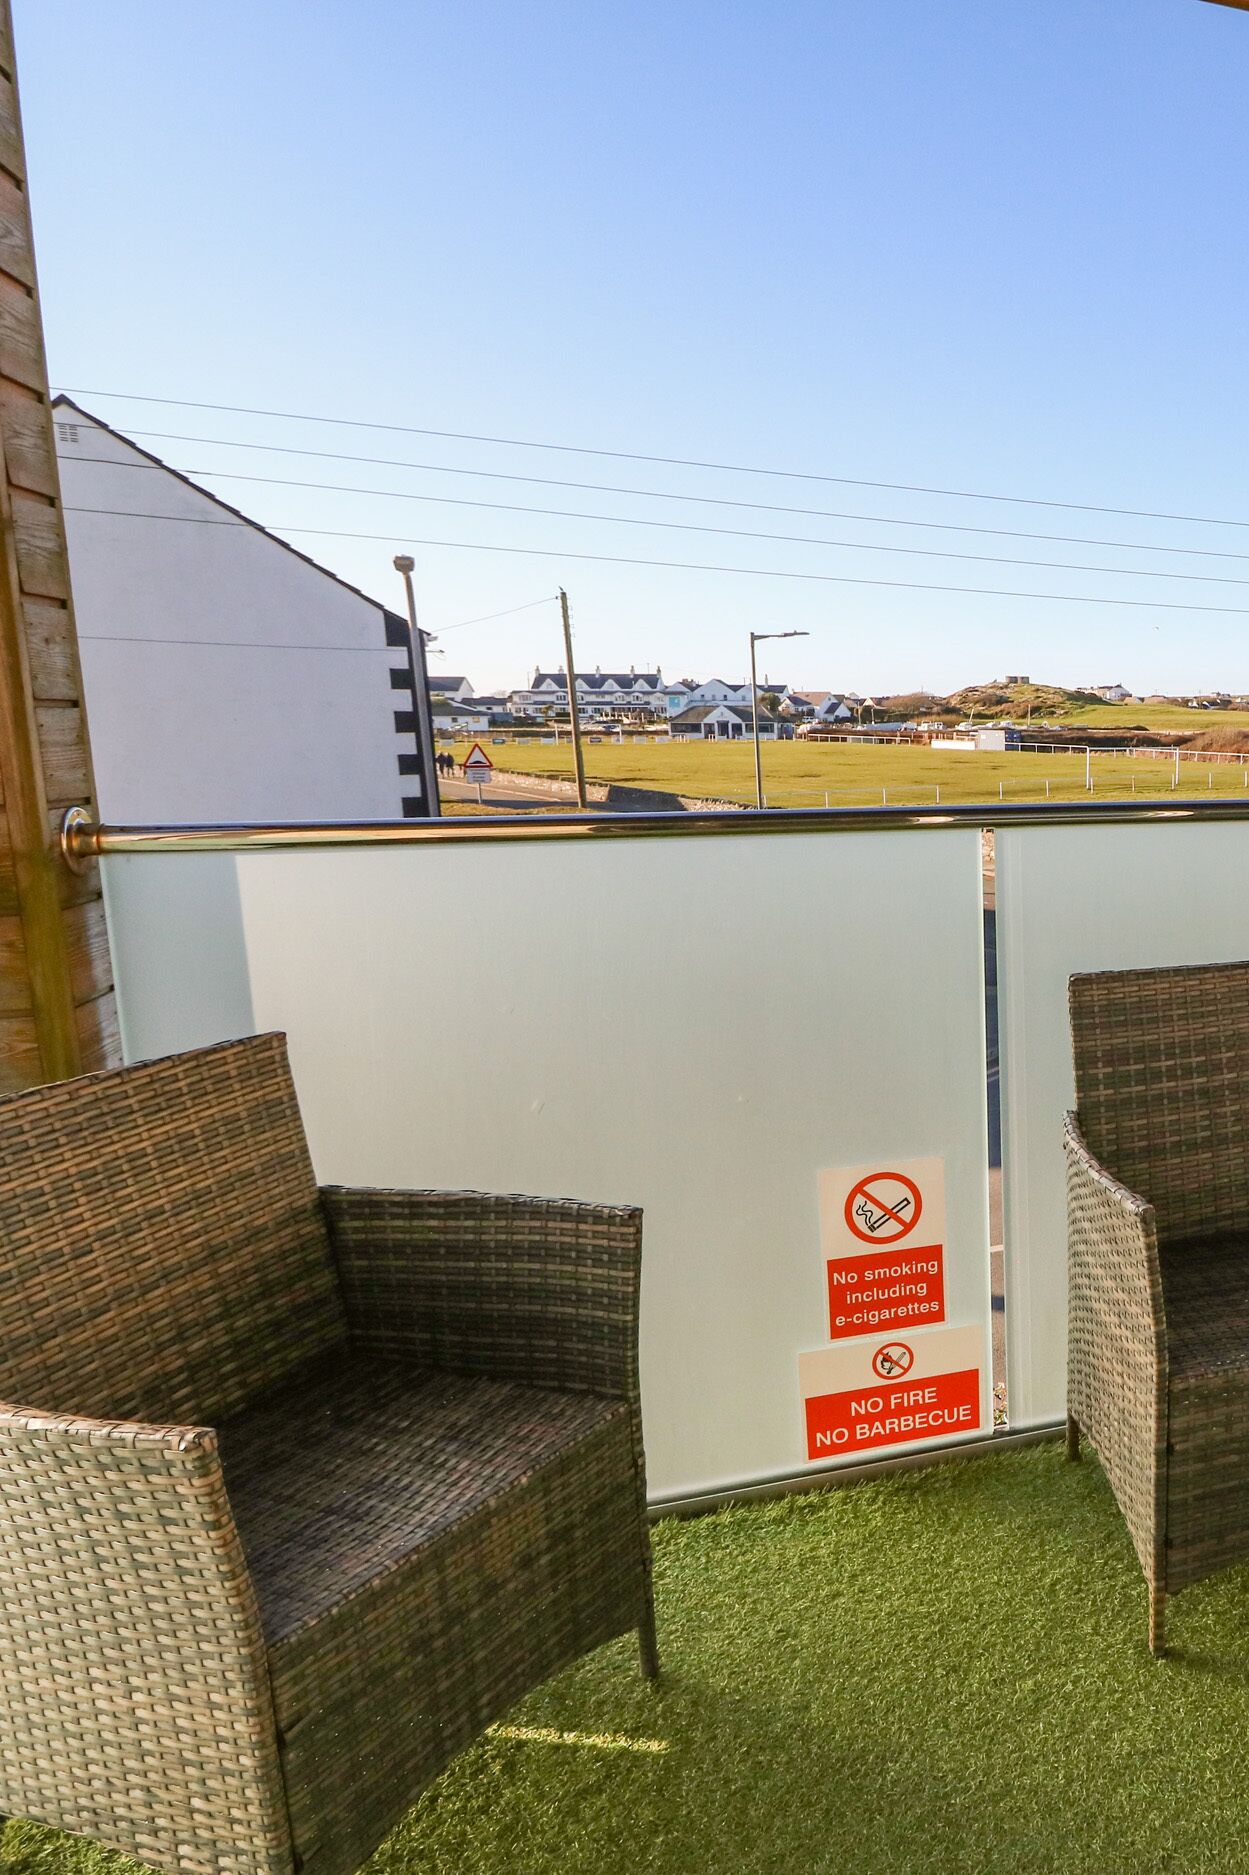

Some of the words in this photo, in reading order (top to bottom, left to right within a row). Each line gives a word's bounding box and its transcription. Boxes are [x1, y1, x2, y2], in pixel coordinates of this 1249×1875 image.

[834, 1272, 858, 1286] No
[864, 1261, 938, 1281] smoking
[847, 1282, 927, 1304] including
[836, 1301, 939, 1325] e-cigarettes
[851, 1397, 883, 1417] NO
[890, 1388, 937, 1409] FIRE
[816, 1425, 848, 1447] NO
[856, 1405, 971, 1440] BARBECUE
